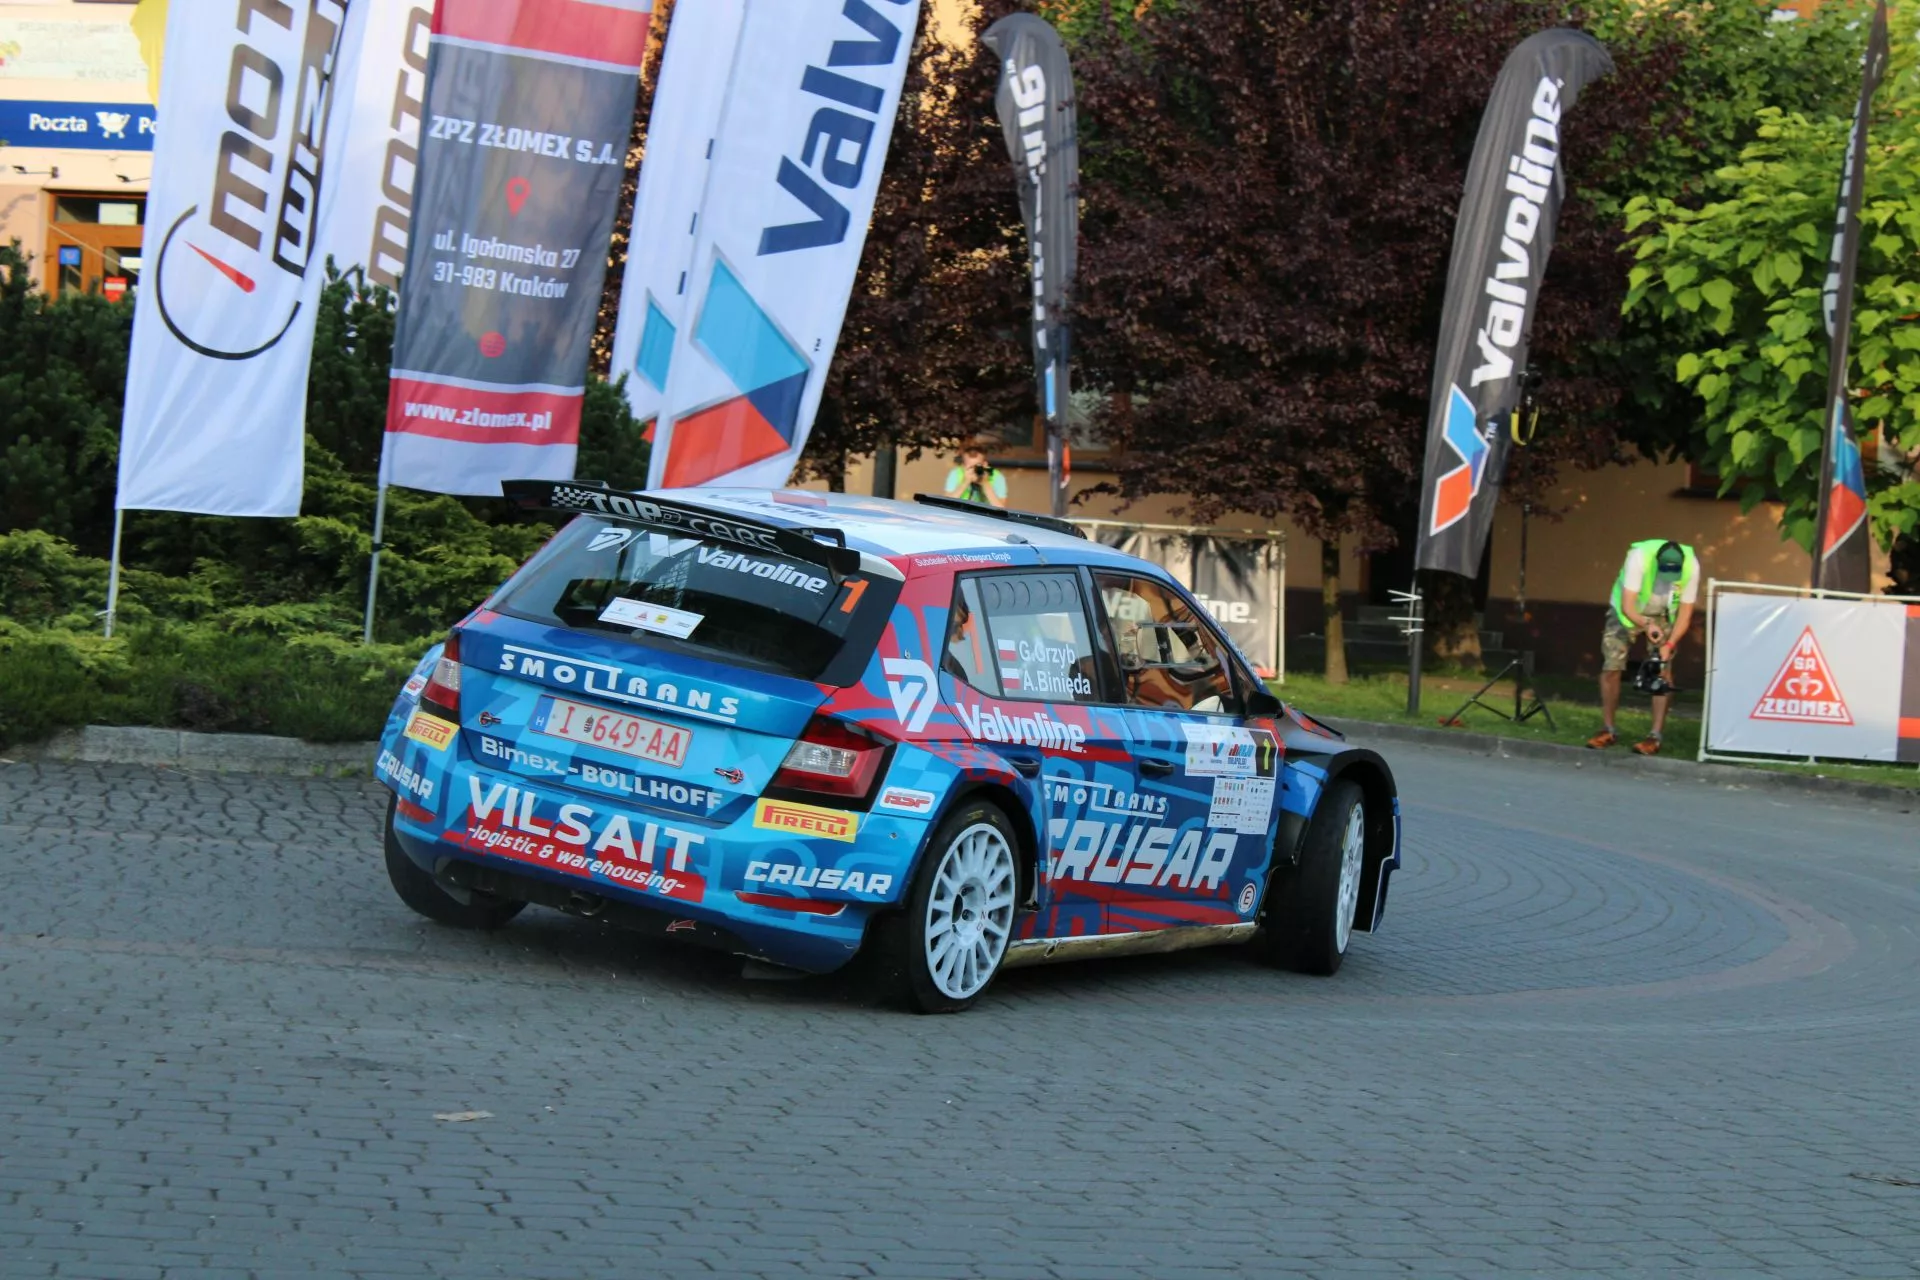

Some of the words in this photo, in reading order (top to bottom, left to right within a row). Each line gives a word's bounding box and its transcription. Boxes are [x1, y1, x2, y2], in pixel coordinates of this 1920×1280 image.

[29, 113, 88, 132] Poczta
[429, 115, 475, 144] ZPZ
[478, 123, 571, 160] ZŁOMEX
[575, 139, 618, 165] S.A.
[757, 0, 913, 257] Valv
[434, 230, 455, 251] ul.
[462, 232, 557, 268] Igołomska
[560, 248, 581, 269] 27
[1471, 75, 1563, 388] Valvoline
[434, 261, 496, 290] 31-983
[499, 271, 569, 298] Kraków
[404, 402, 552, 431] www.zlomex.pl
[697, 545, 828, 595] Valvoline
[947, 554, 962, 564] FIAT
[839, 578, 870, 614] 1
[1019, 640, 1076, 669] G.Grzyb
[499, 644, 741, 725] SMOLTRANS
[407, 716, 452, 745] PIRELLI
[536, 716, 546, 728] H
[955, 703, 1087, 754] Valvoline
[376, 748, 435, 800] CRUSAR
[469, 775, 706, 873] VILSAIT
[762, 804, 850, 836] PIRELLI
[538, 844, 554, 859] &
[744, 860, 893, 896] CRUSAR
